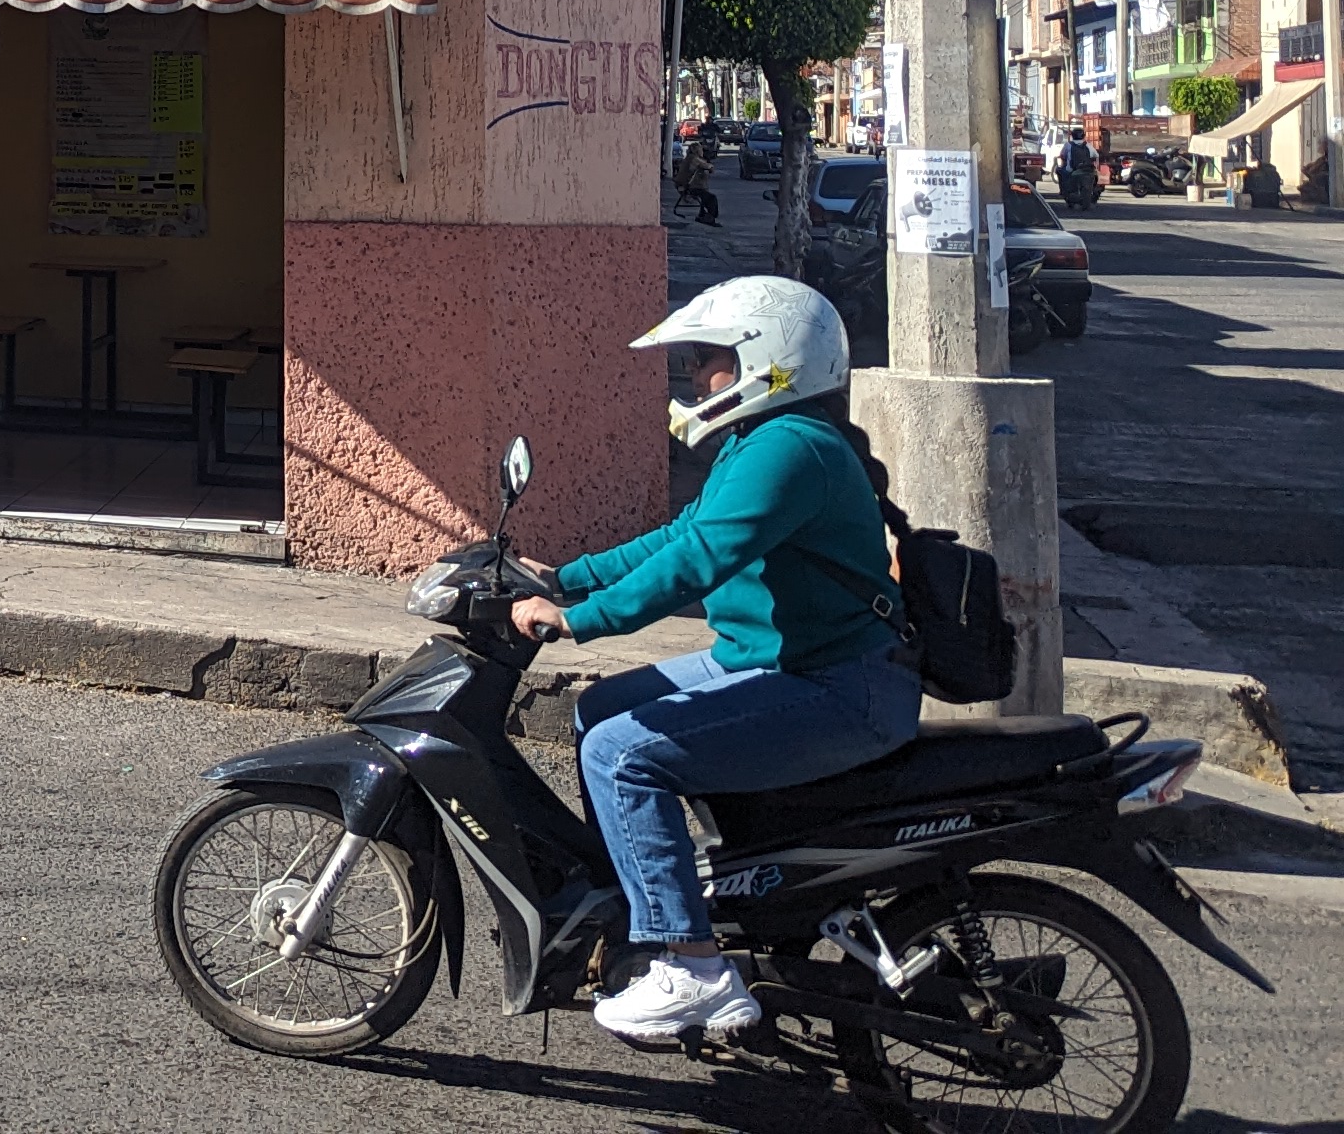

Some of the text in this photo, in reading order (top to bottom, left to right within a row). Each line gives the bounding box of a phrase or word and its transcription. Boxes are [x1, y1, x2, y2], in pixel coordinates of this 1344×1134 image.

[496, 39, 661, 116] DON GUS
[906, 169, 967, 177] PREPARATORIA
[921, 177, 958, 186] MESES
[894, 814, 973, 841] ITALIKA
